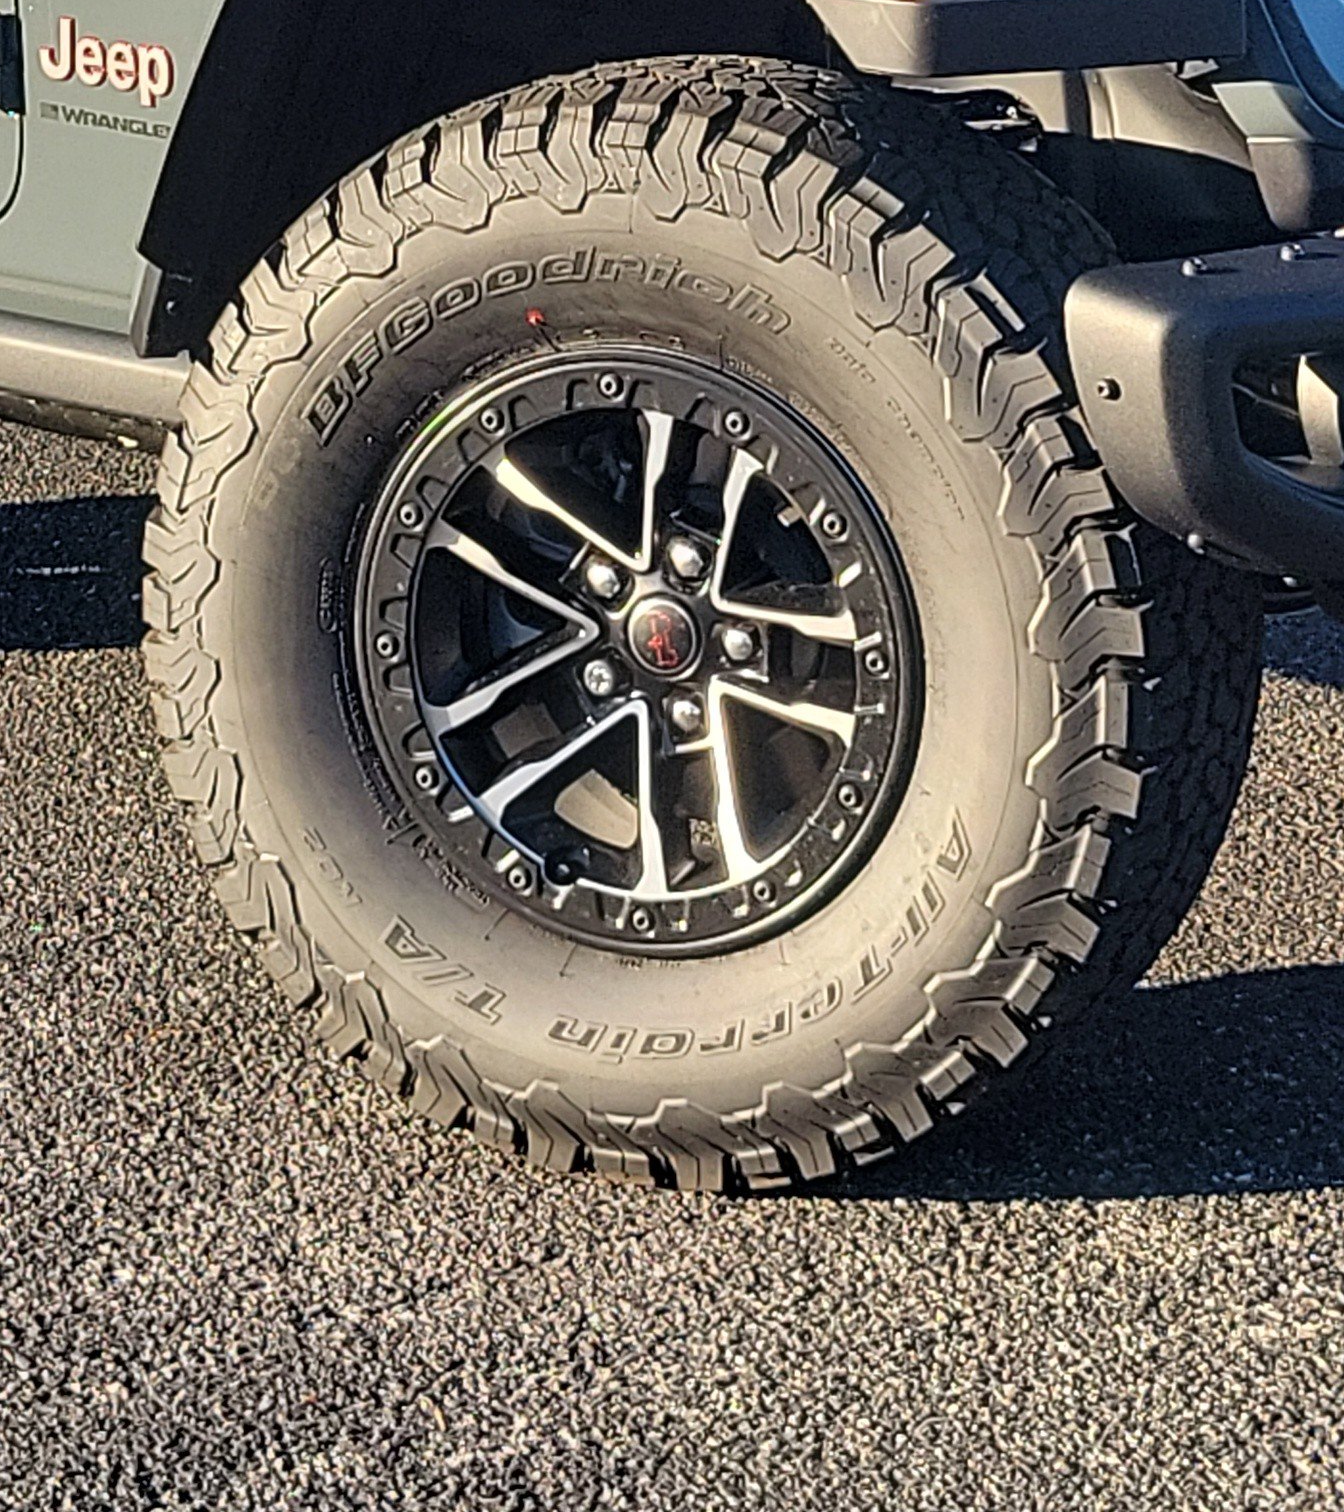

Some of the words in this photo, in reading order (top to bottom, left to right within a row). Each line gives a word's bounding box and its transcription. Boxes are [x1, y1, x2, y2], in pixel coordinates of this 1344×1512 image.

[38, 15, 175, 108] Jeep
[61, 104, 172, 139] WRANGLE
[302, 245, 792, 448] BFGoodrich
[378, 914, 507, 1026] T/A
[546, 807, 973, 1065] All-Terrain
